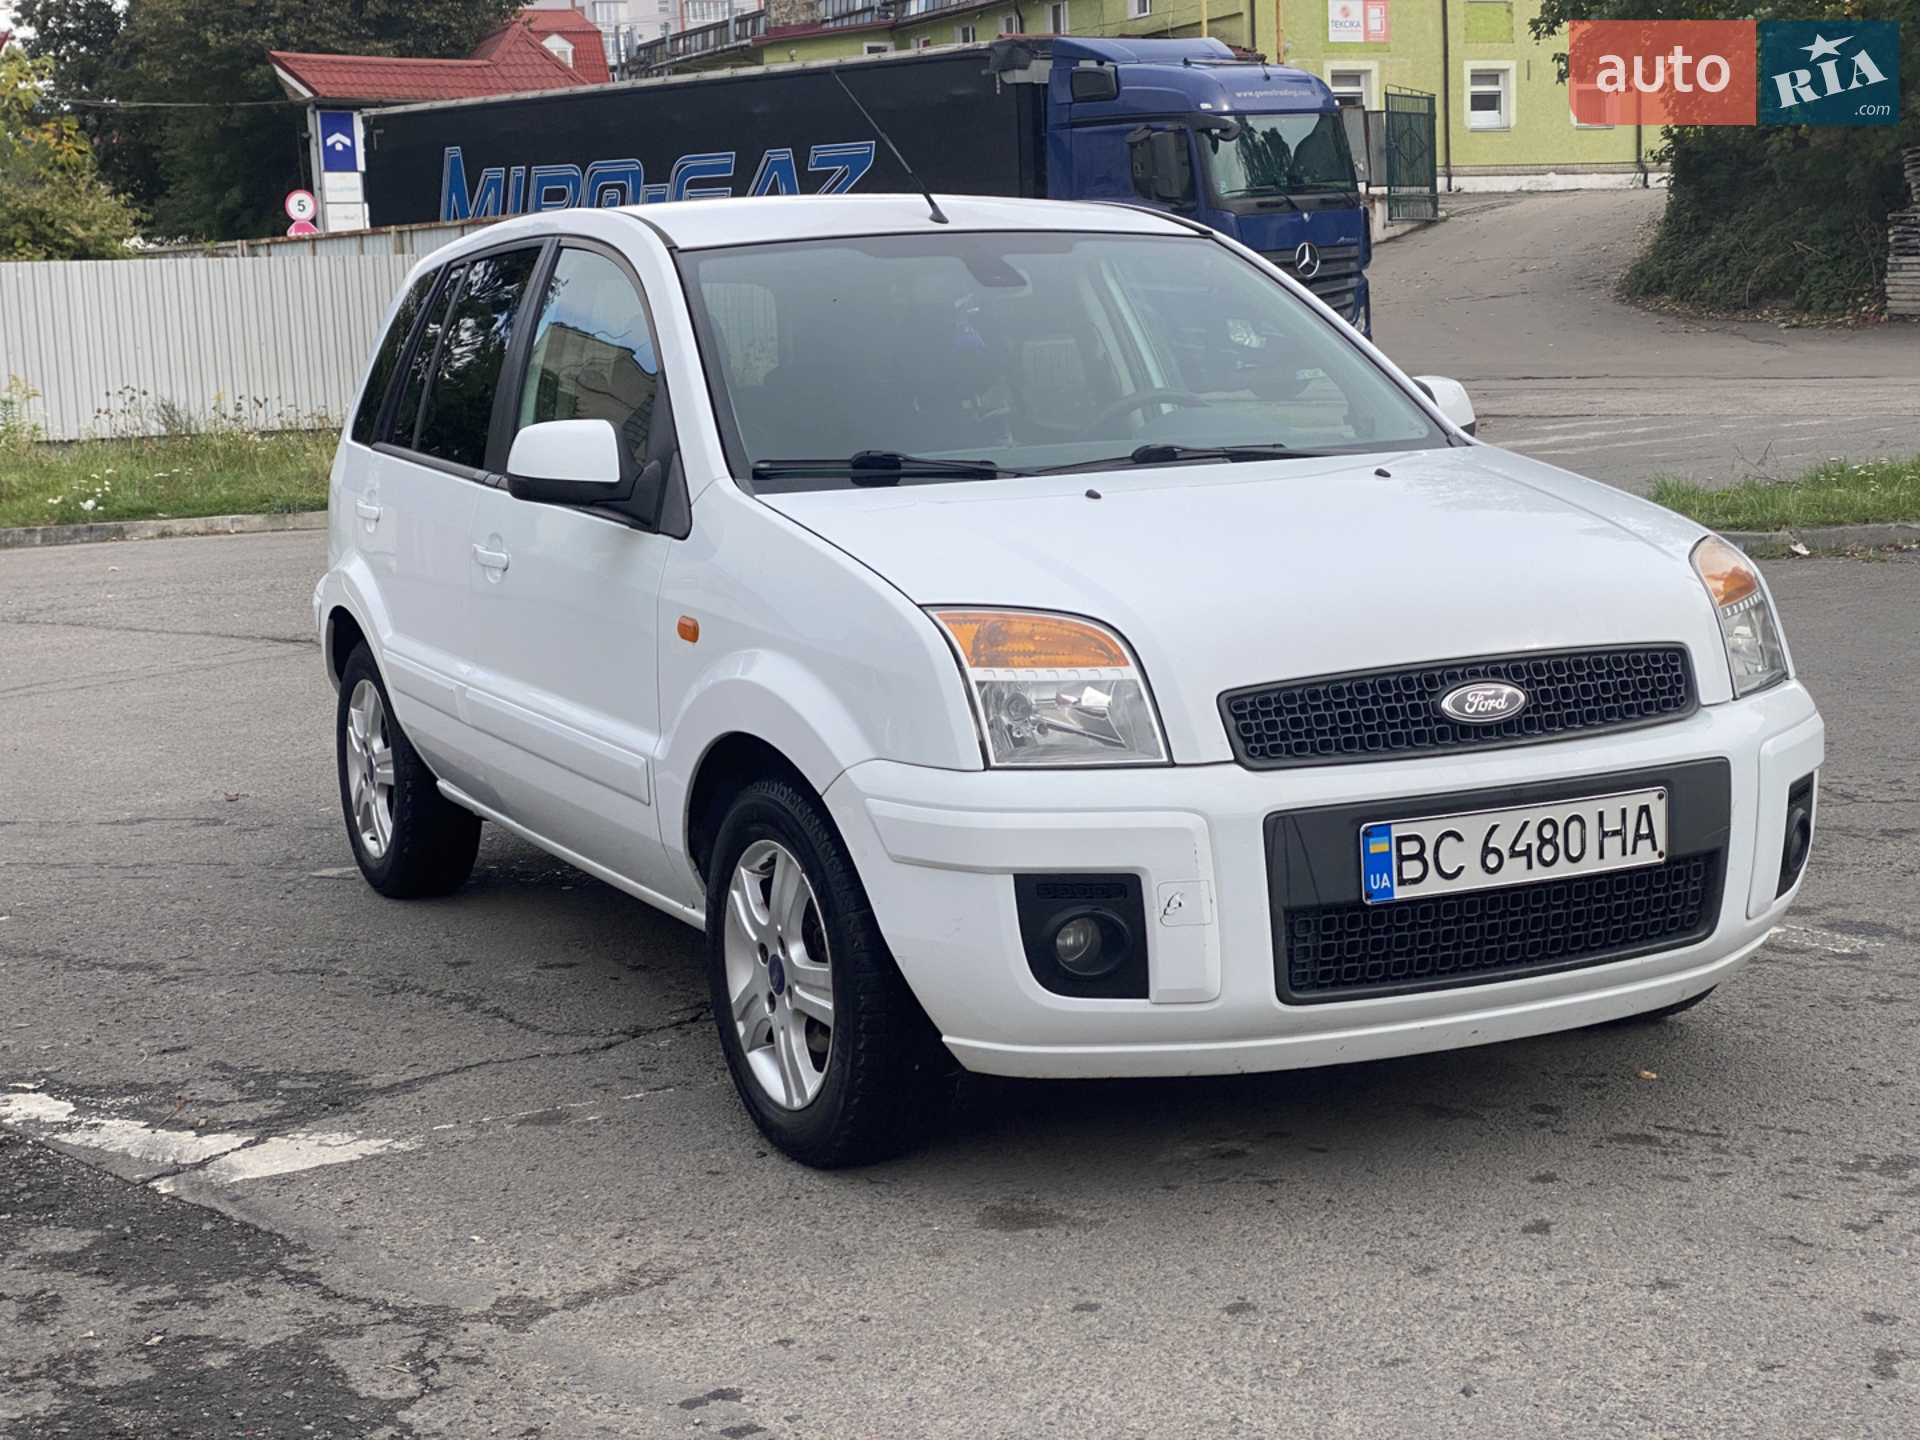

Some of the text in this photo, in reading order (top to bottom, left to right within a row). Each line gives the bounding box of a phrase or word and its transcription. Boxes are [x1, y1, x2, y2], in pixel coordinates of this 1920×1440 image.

[297, 200, 306, 212] 5
[1464, 688, 1509, 714] Ford
[1395, 803, 1659, 887] BC 6480 HA
[1370, 873, 1391, 890] UA
